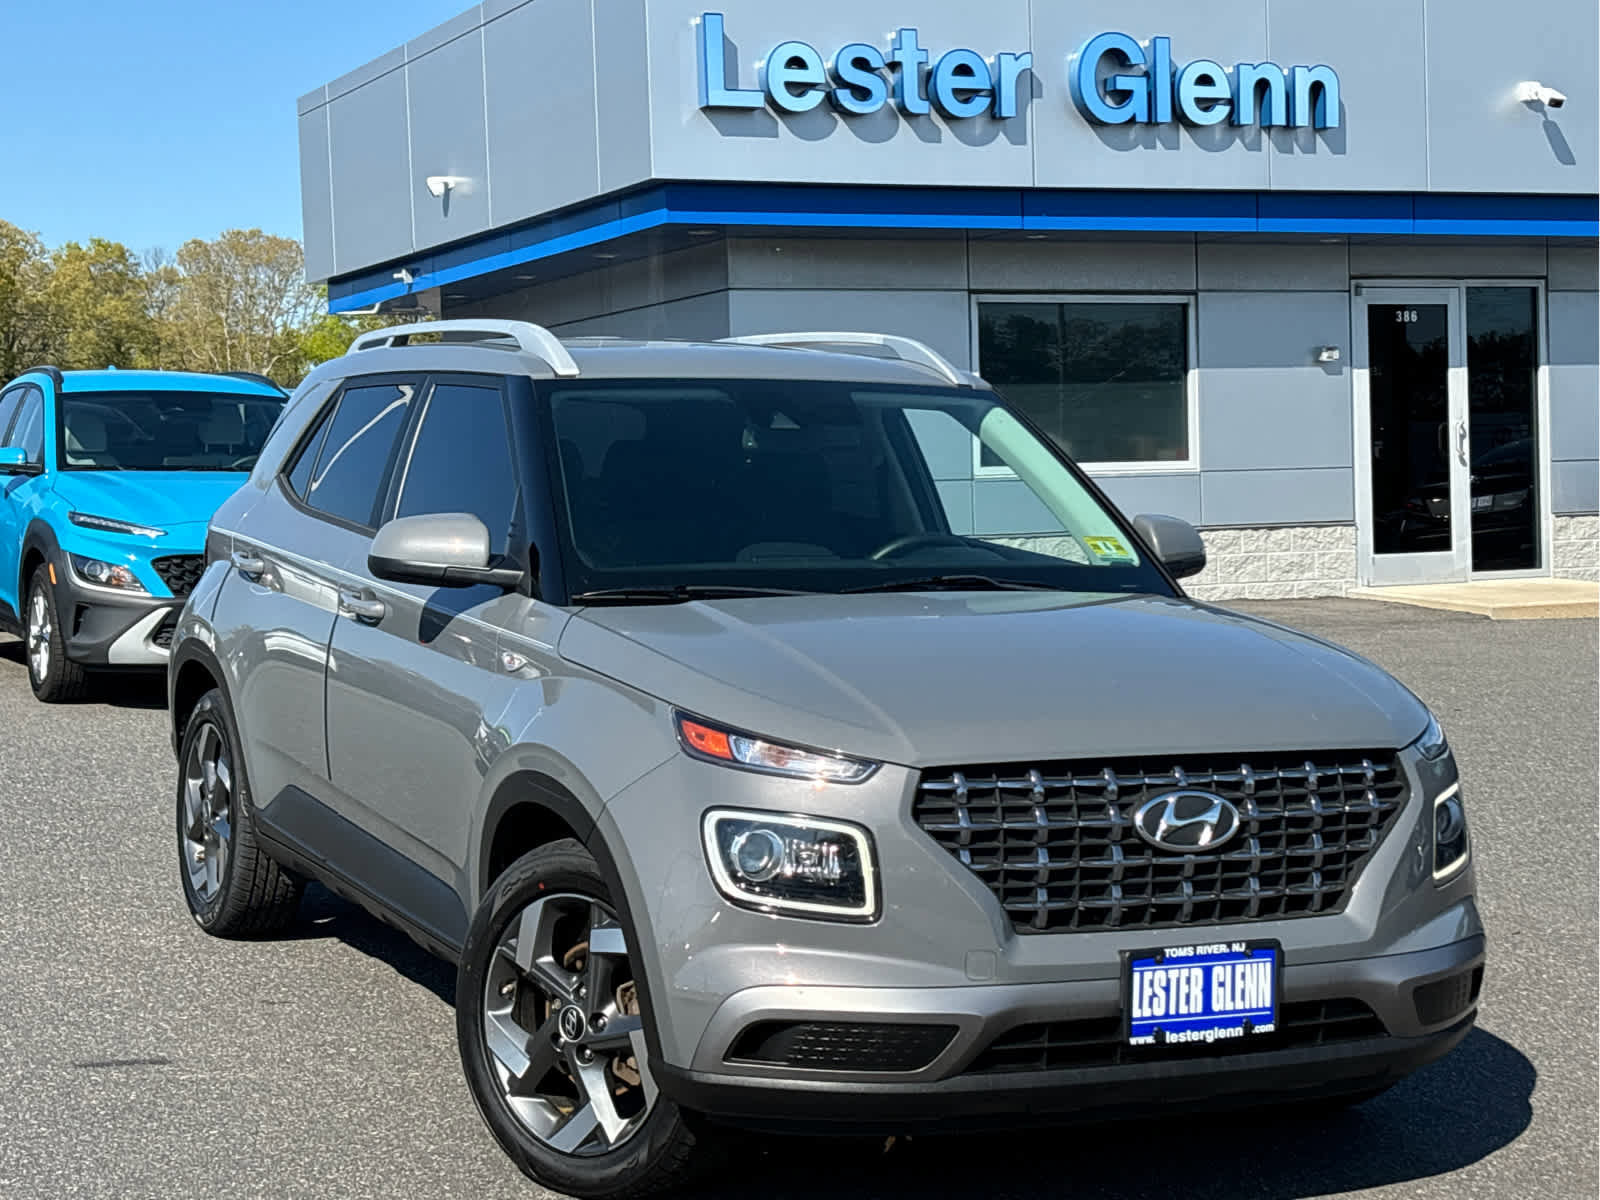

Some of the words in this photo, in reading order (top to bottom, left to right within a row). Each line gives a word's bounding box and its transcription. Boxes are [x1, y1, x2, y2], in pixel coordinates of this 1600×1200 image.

[697, 12, 1032, 119] Lester
[1069, 31, 1340, 129] Glenn
[1395, 310, 1418, 322] 386
[1164, 947, 1194, 958] TOMS
[1231, 942, 1246, 953] NJ
[1132, 967, 1203, 1018] LESTER
[1211, 962, 1272, 1012] GLENN
[1165, 1027, 1244, 1043] lesterglenn
